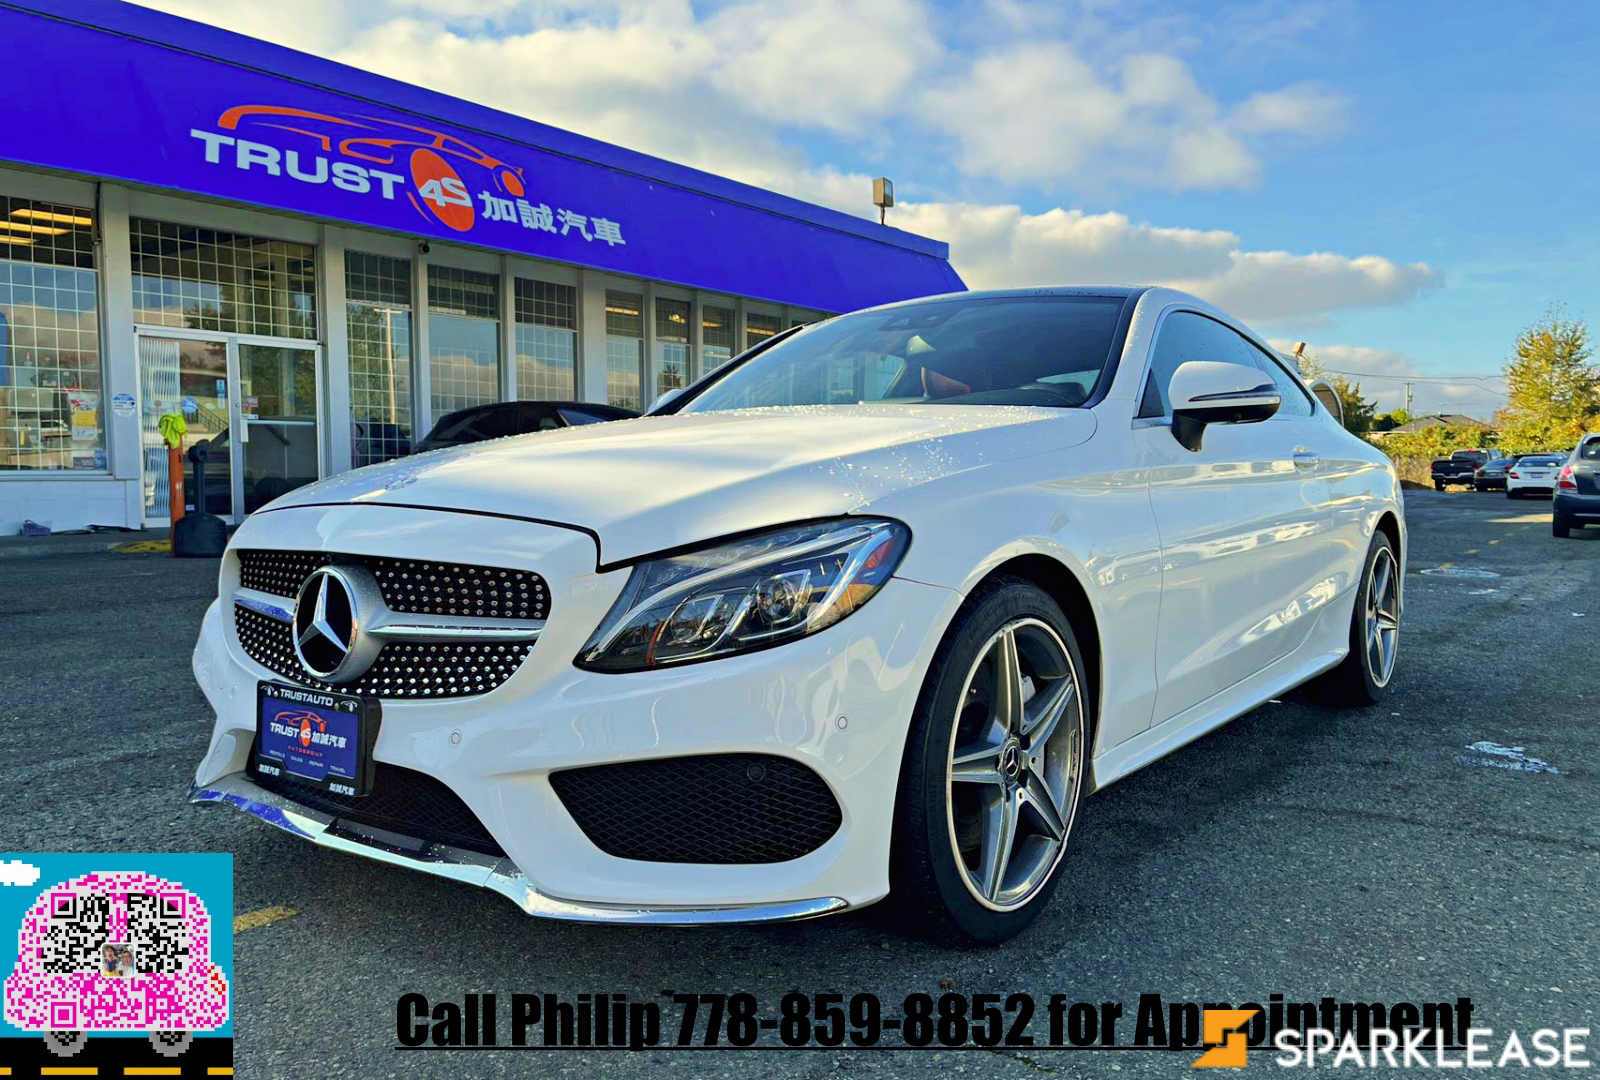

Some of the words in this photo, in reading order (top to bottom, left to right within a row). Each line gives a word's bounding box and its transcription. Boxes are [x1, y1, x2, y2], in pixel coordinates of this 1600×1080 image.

[190, 128, 405, 200] TRUST
[419, 176, 473, 207] 4S
[477, 190, 627, 247] 加誠汽車
[280, 688, 334, 707] TRUSTAUTO
[269, 722, 300, 738] TRUST
